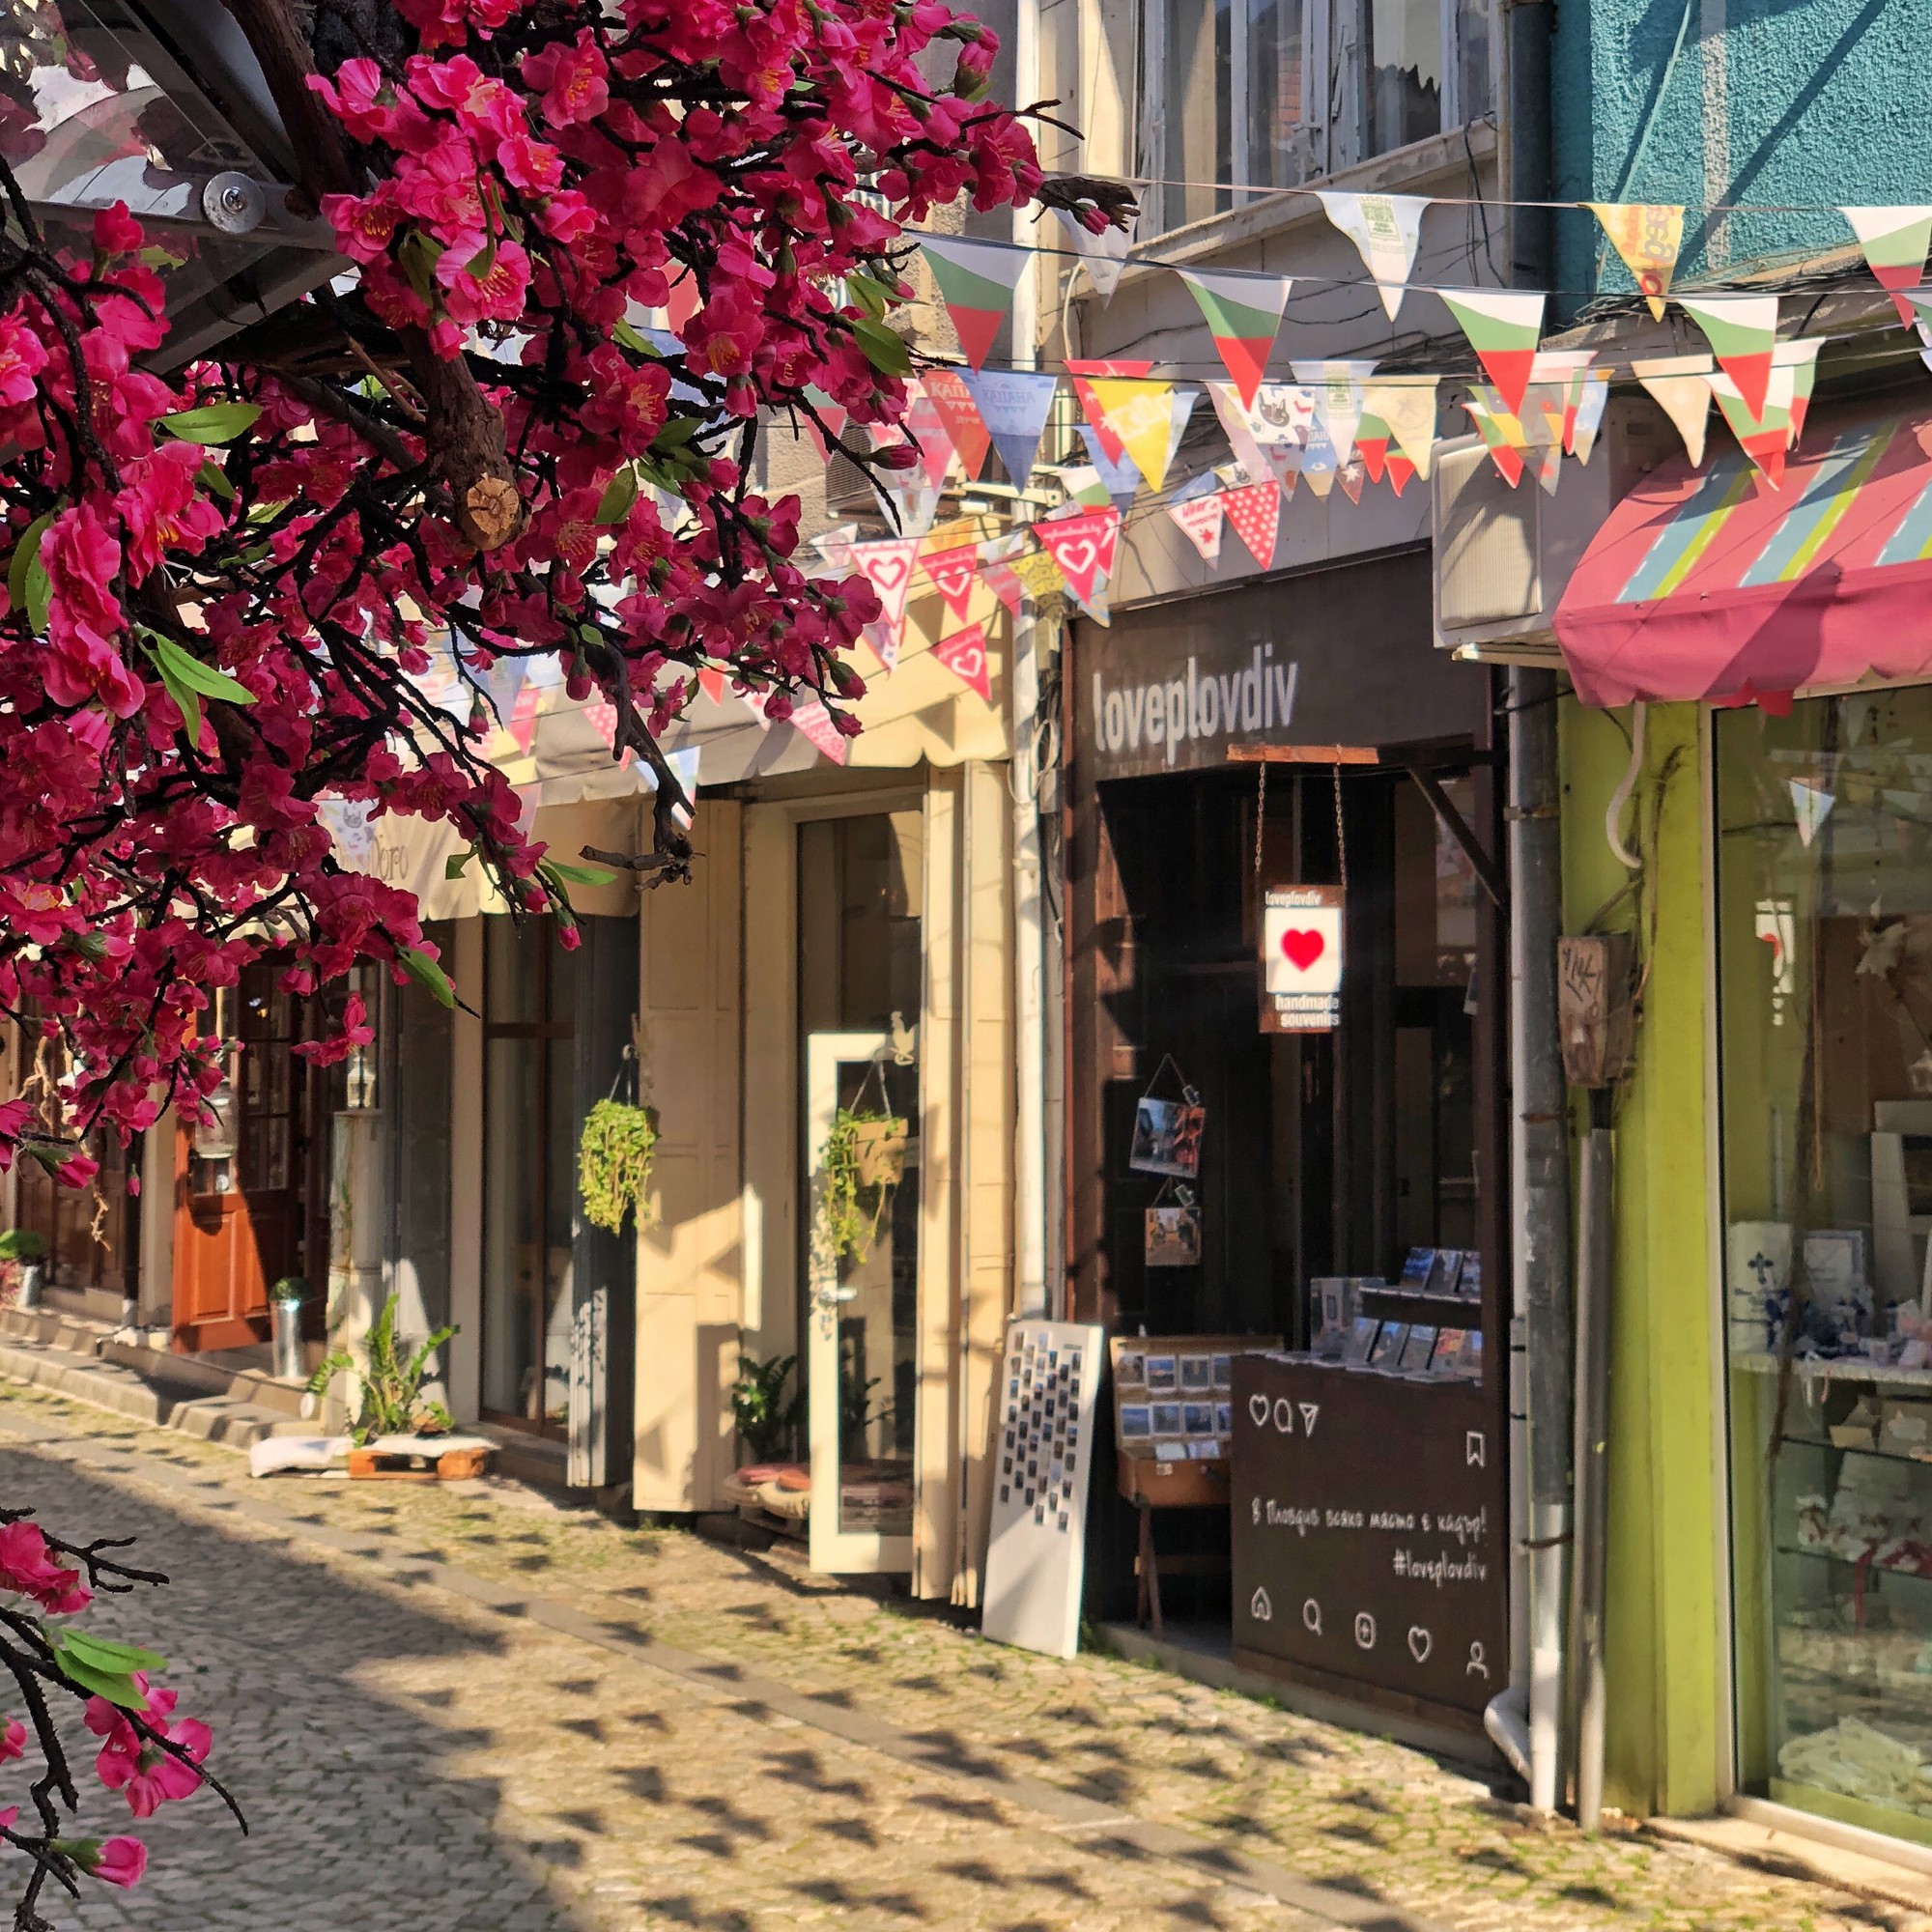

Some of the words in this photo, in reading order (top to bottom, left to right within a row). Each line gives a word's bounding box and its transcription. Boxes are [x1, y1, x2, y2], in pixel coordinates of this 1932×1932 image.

[1093, 642, 1298, 765] loveplovdiv
[1264, 891, 1322, 907] loveplovdiv
[1275, 994, 1339, 1010] handmade
[1280, 1012, 1340, 1028] souvenirs
[1393, 1548, 1488, 1588] #loveplovdiv
